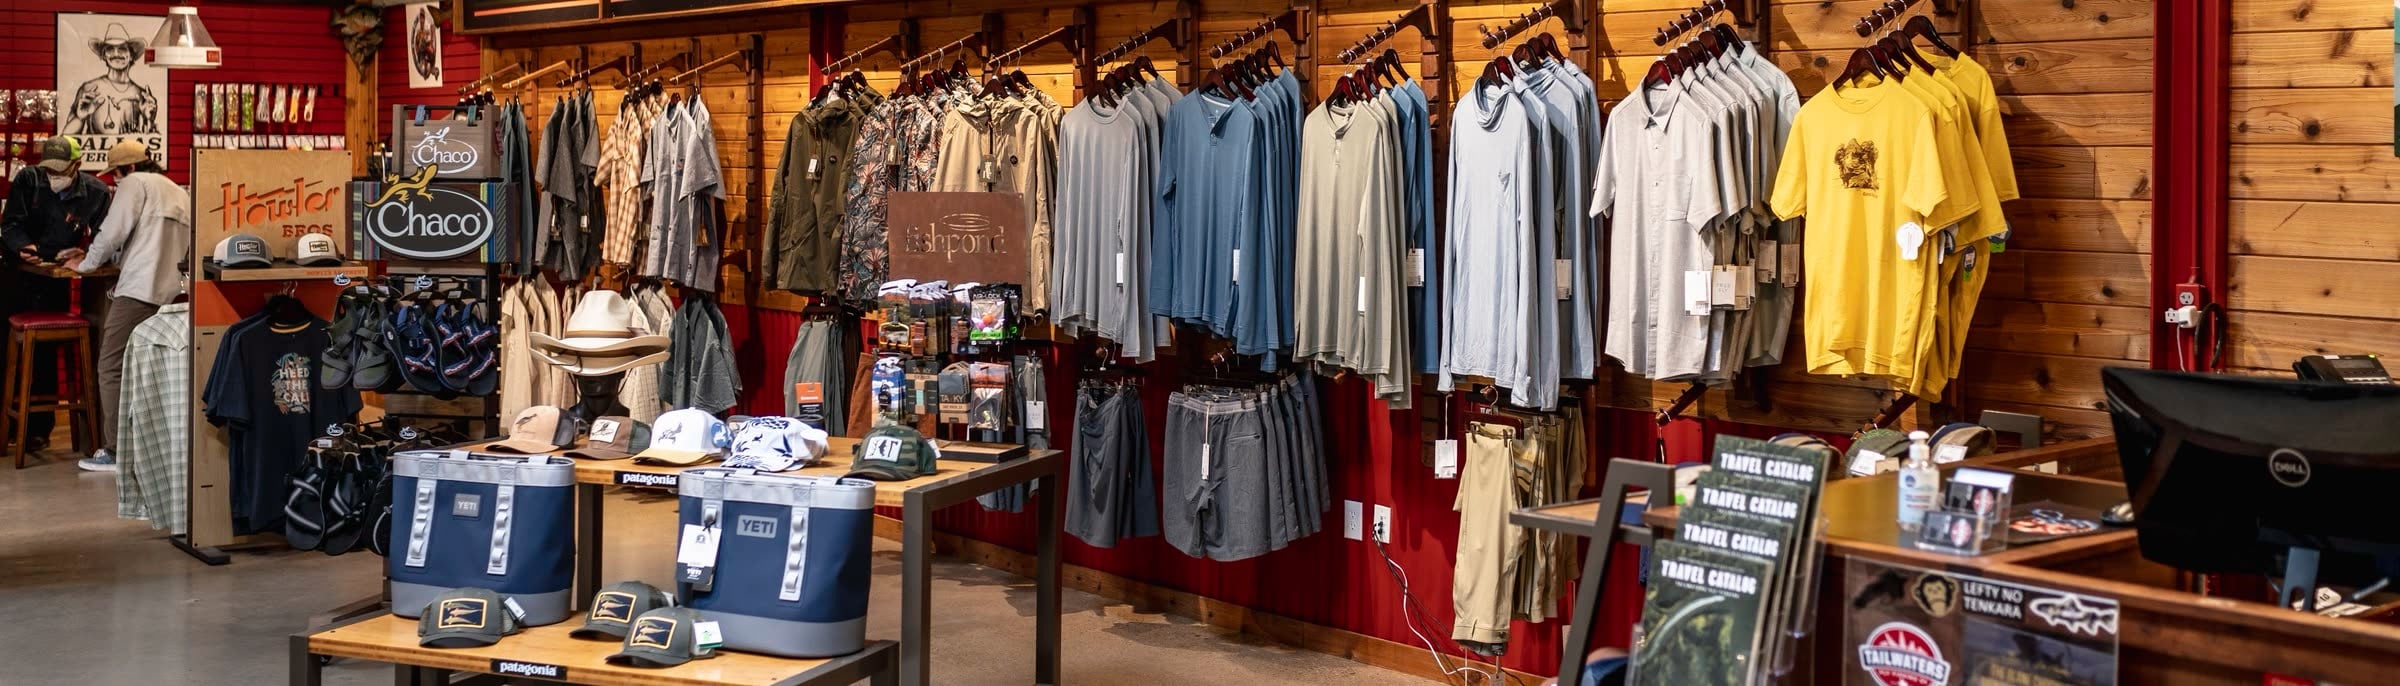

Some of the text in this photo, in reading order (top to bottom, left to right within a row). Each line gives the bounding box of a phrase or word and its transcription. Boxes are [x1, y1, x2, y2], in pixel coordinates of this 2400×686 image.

[418, 144, 472, 163] Chaco
[209, 177, 340, 231] Howler
[377, 201, 481, 237] Chaco
[282, 224, 333, 238] BROS
[905, 223, 1008, 263] fishpond
[280, 368, 310, 379] HEED
[286, 380, 308, 390] THE
[1720, 453, 1762, 475] TRAVEL
[1765, 460, 1814, 482] CATALOG
[622, 473, 677, 486] patagonia
[458, 501, 477, 510] YETI
[1703, 487, 1746, 511] TRAVEL
[1749, 496, 1798, 519] CATALOG
[742, 519, 775, 534] YETI
[1684, 523, 1728, 548] TRAVEL
[1731, 533, 1779, 557] CATALOG
[1661, 559, 1705, 585] TRAVEL
[1707, 569, 1757, 595] CATALOG
[1962, 582, 2024, 603] LEFTY NO
[1962, 596, 2022, 620] TENKARA
[500, 662, 557, 676] patagonia
[1864, 650, 1945, 679] TAILWATERS
